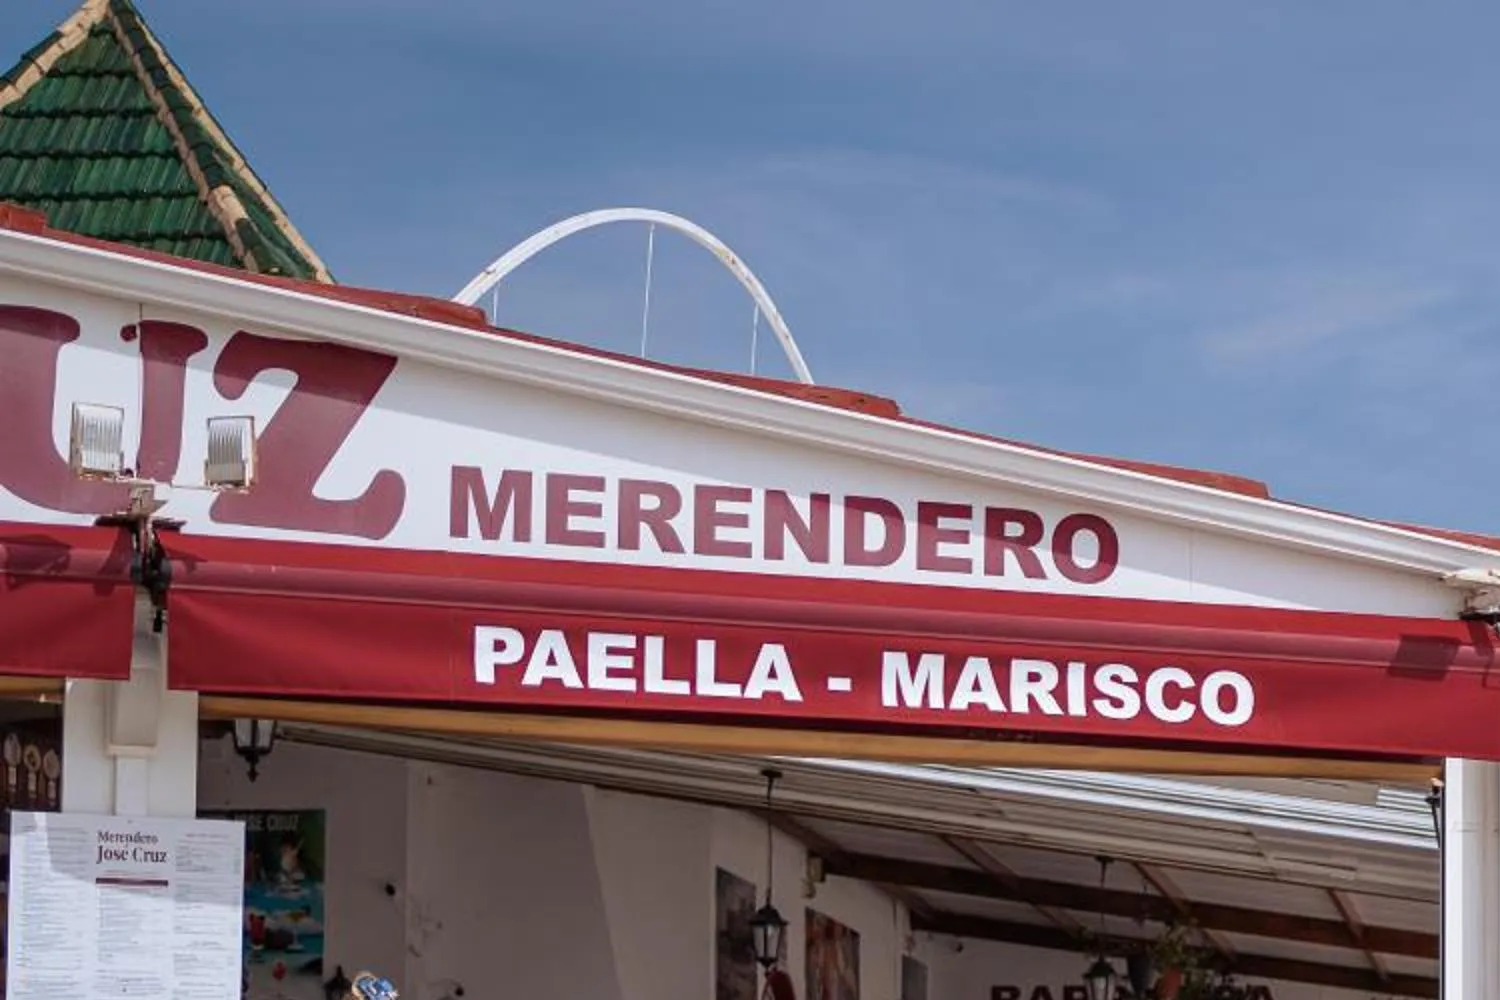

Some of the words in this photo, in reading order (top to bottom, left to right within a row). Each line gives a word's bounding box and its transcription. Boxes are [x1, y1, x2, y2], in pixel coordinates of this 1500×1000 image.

[0, 305, 406, 540] UZ
[449, 466, 1119, 584] MERENDERO
[473, 625, 802, 701] PAELLA
[828, 677, 852, 692] -
[882, 651, 1255, 725] MARISCO
[97, 831, 159, 844] Merendero
[132, 847, 168, 864] Cruz
